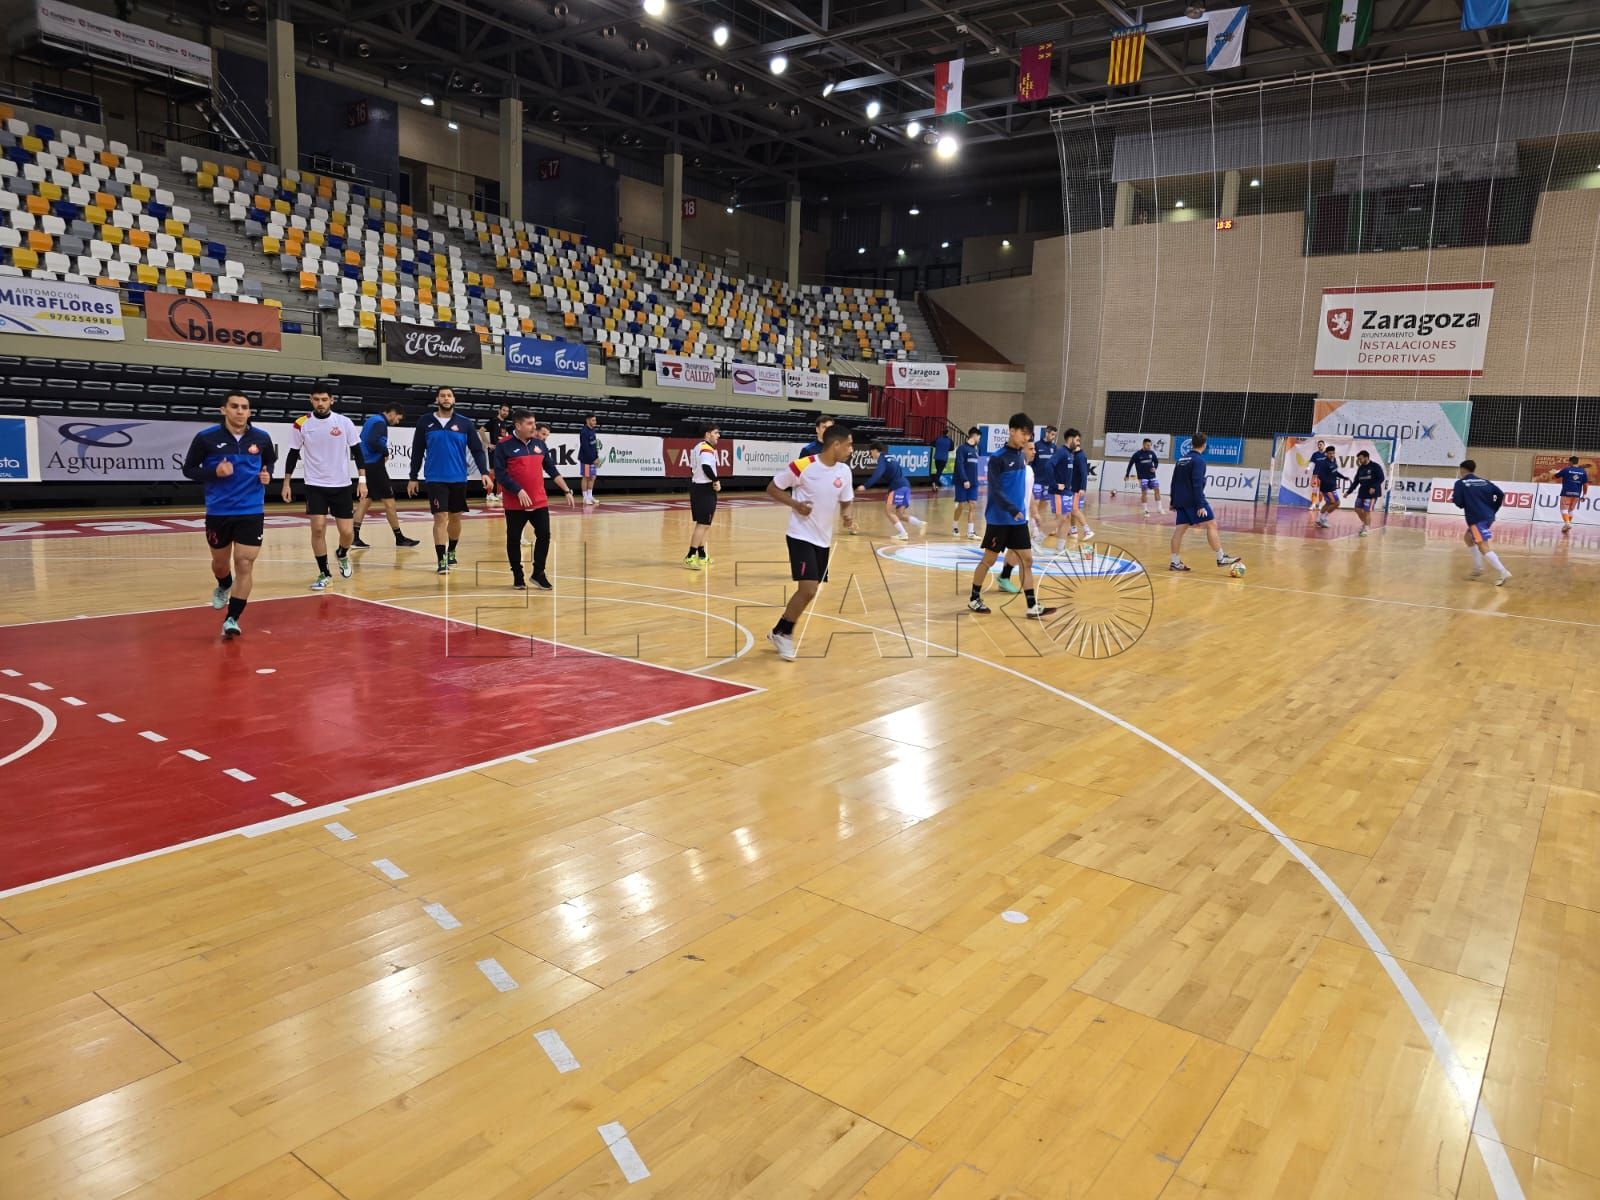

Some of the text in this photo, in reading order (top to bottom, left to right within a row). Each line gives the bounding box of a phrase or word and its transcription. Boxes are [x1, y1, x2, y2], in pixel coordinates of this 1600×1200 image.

[684, 201, 695, 215] 18
[15, 287, 80, 300] AUTOMOCIÓN
[188, 318, 263, 346] blesa
[1361, 310, 1481, 336] Zaragoza
[424, 334, 465, 357] Criollo
[1361, 331, 1414, 339] AYUNTAMIENTO
[508, 342, 586, 371] Forus Forus
[684, 369, 715, 384] CALLIZO
[908, 368, 940, 378] Zaragoza
[1337, 420, 1439, 444] wanapix
[47, 451, 165, 474] Agrupamm
[1205, 472, 1257, 491] napix
